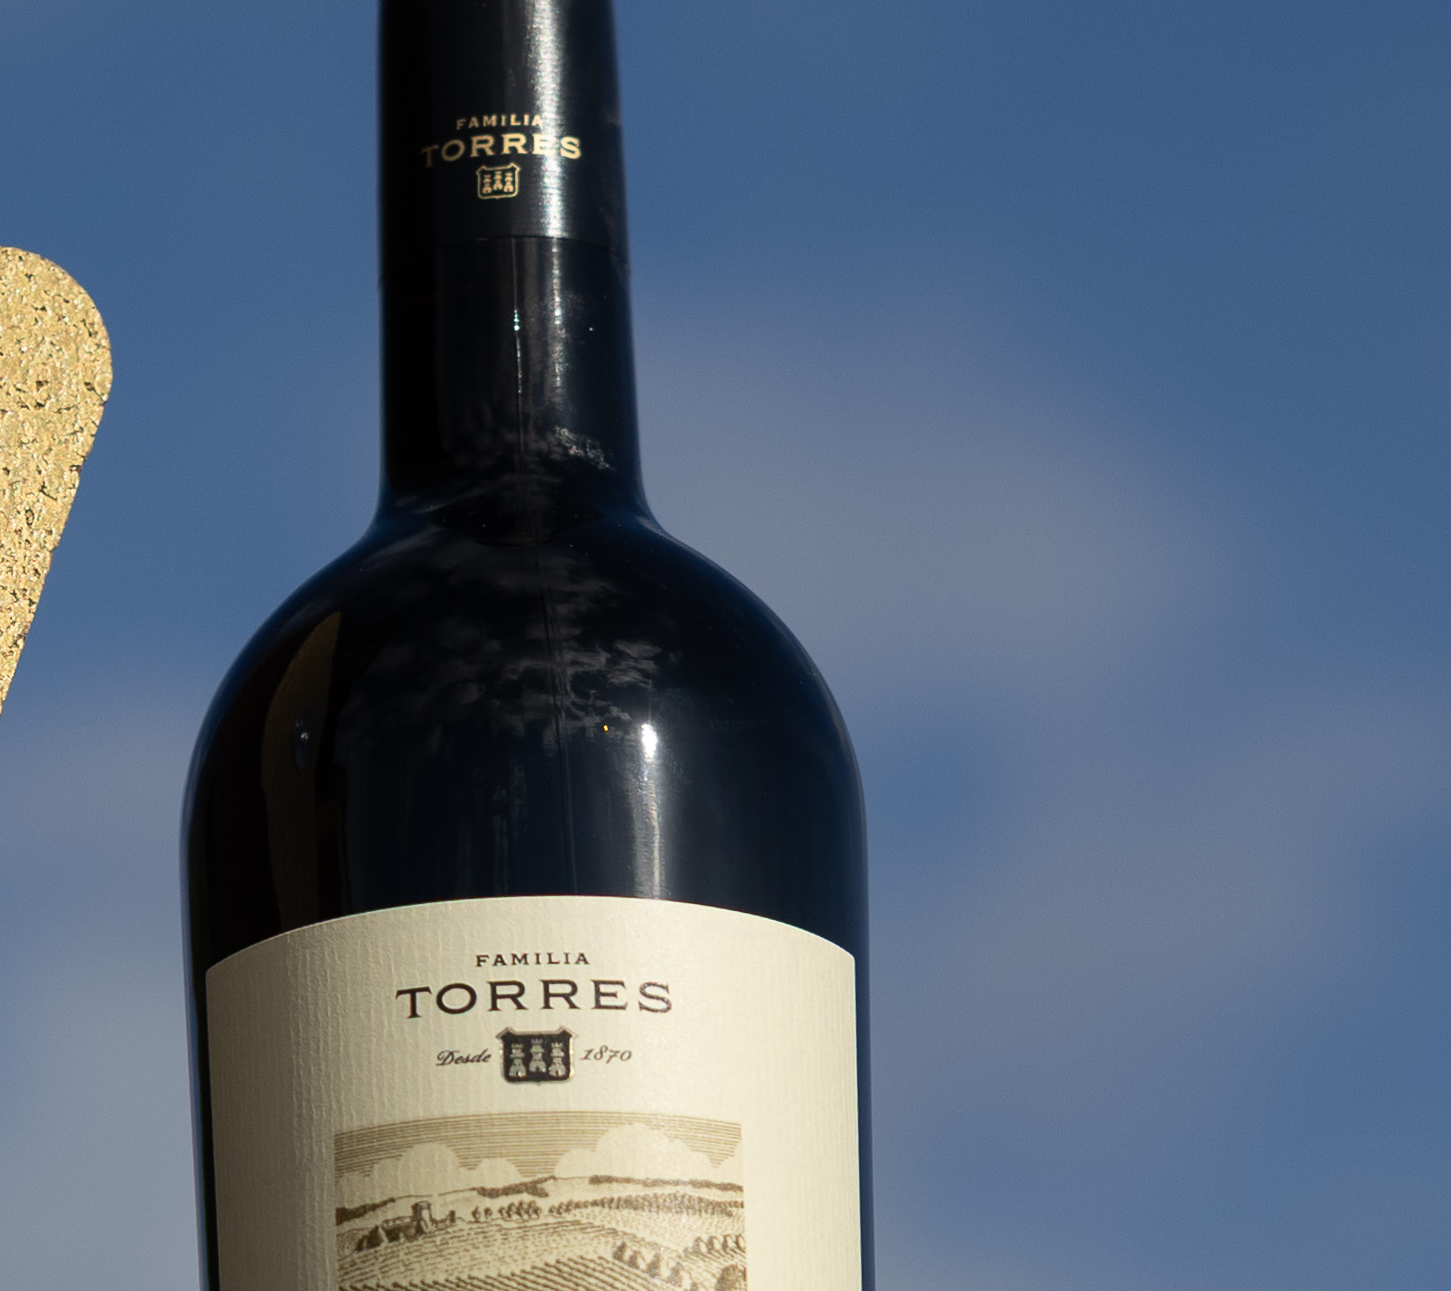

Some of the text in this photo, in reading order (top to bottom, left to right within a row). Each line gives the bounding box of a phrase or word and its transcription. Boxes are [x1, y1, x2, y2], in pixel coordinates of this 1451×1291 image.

[456, 114, 543, 130] FAMILIA
[420, 133, 582, 168] TORRES
[475, 952, 590, 968] FAMILIA
[395, 978, 673, 1020] TORRES
[435, 1045, 633, 1067] Desde 1870
